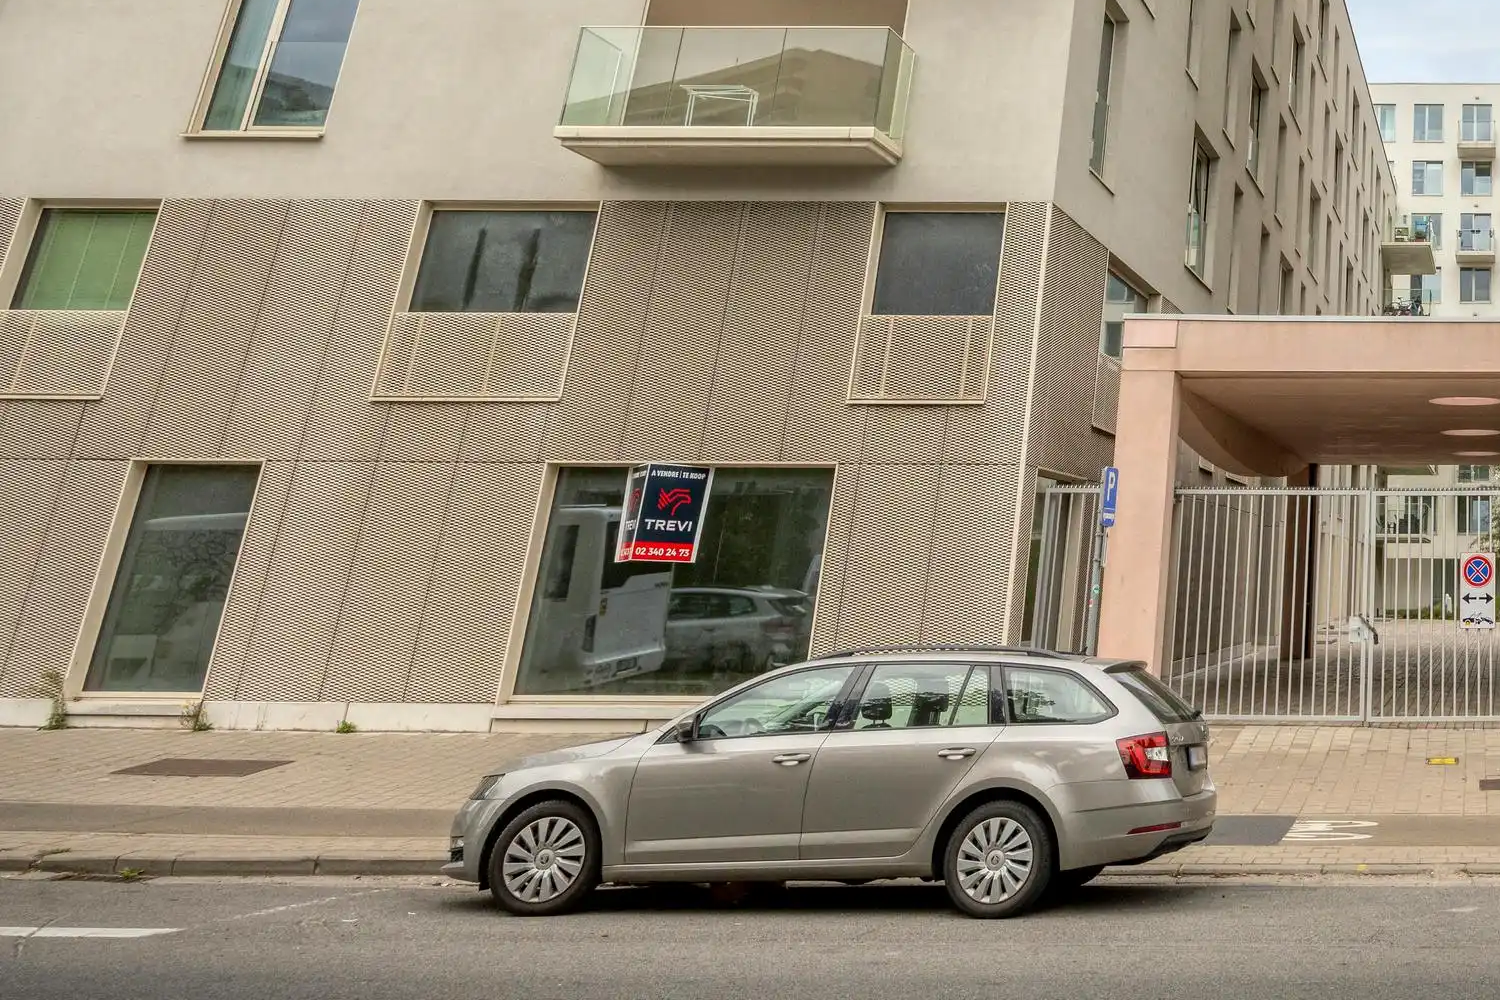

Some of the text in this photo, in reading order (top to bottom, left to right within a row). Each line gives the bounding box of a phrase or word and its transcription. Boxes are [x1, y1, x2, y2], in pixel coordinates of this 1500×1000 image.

[657, 470, 680, 478] VENDRE
[1107, 471, 1116, 502] P
[644, 518, 693, 532] TREVI
[635, 547, 646, 556] 02
[647, 548, 664, 556] 340
[665, 548, 677, 557] 24
[678, 549, 690, 557] 73
